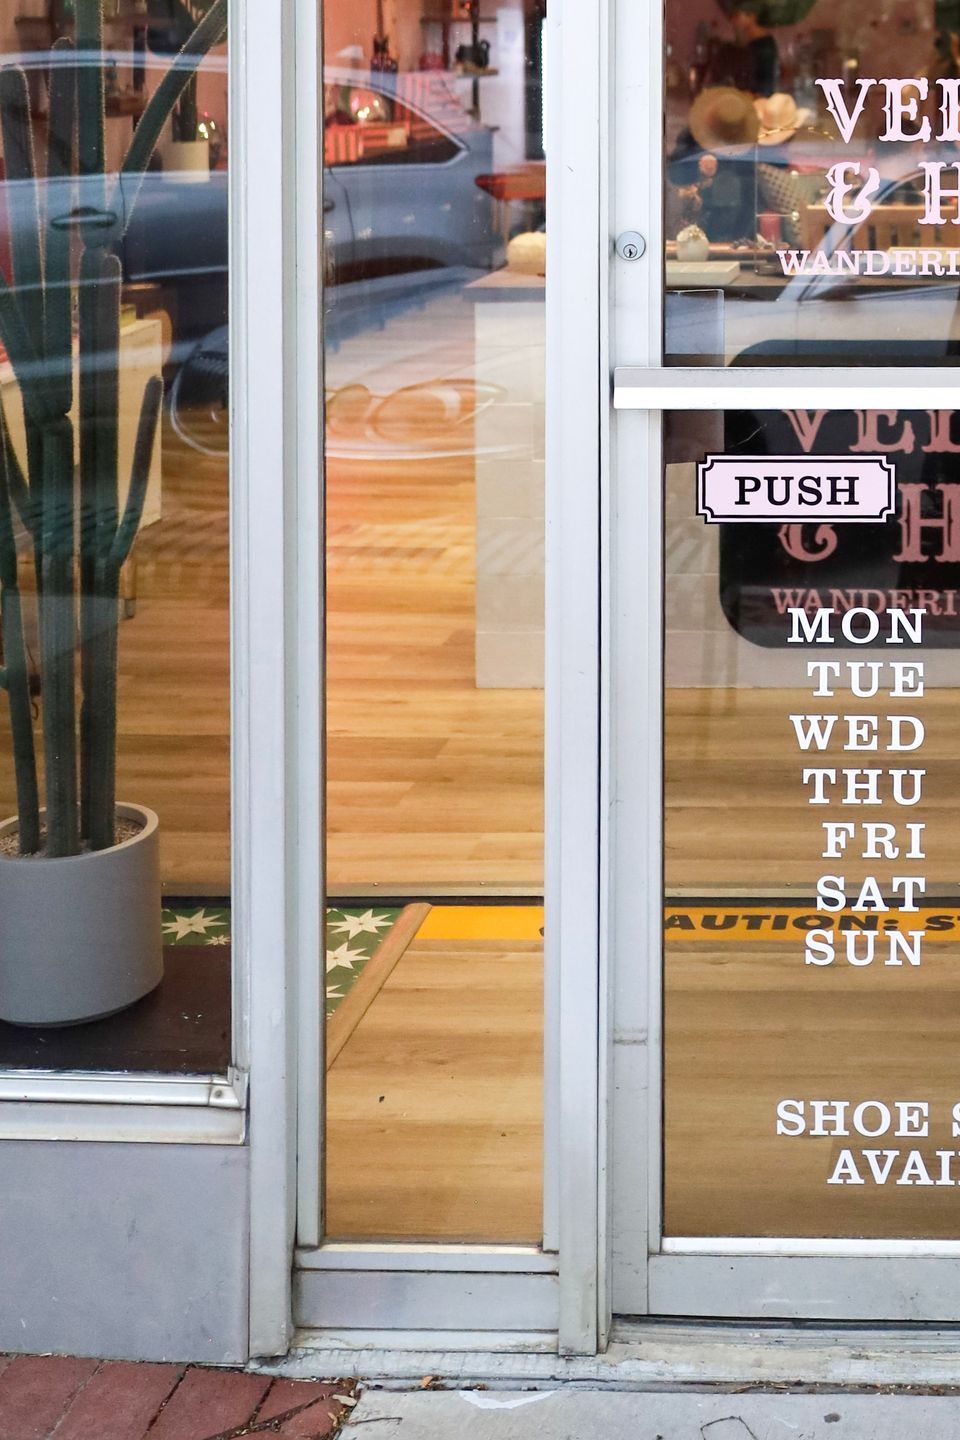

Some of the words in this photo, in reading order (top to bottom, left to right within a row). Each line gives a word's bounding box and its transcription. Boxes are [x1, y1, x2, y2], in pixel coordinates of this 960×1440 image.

[823, 161, 881, 225] &
[734, 476, 861, 507] PUSH
[787, 607, 926, 643] MON
[807, 661, 925, 697] TUE
[790, 715, 926, 751] WED
[803, 768, 926, 805] THU
[822, 822, 926, 859] FRI
[816, 875, 926, 912] SAT
[664, 914, 898, 931] AUTION:
[805, 929, 926, 966] SUN
[776, 1099, 930, 1137] SHOE
